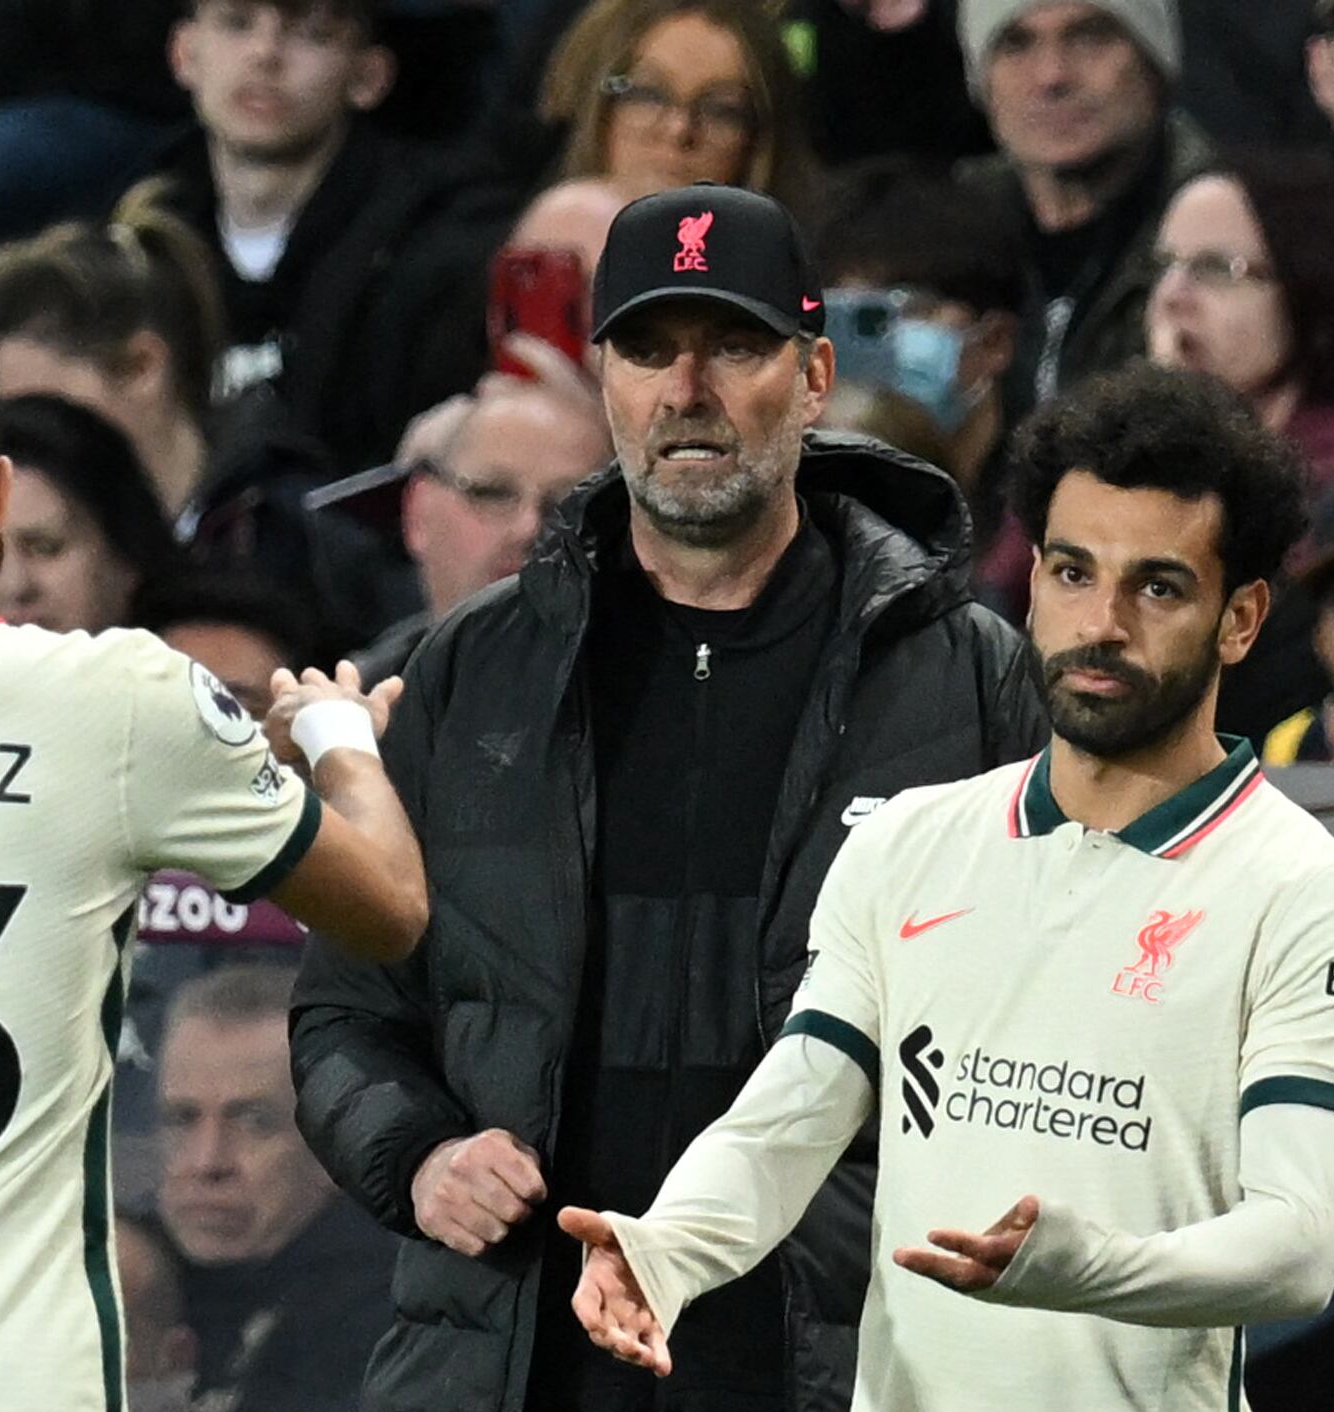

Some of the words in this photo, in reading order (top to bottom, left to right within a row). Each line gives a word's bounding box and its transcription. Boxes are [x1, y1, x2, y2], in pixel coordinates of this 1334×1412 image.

[138, 884, 249, 933] ZOO
[1111, 973, 1165, 1004] LFC
[956, 1046, 1146, 1111] standard
[946, 1086, 1152, 1152] chartered
